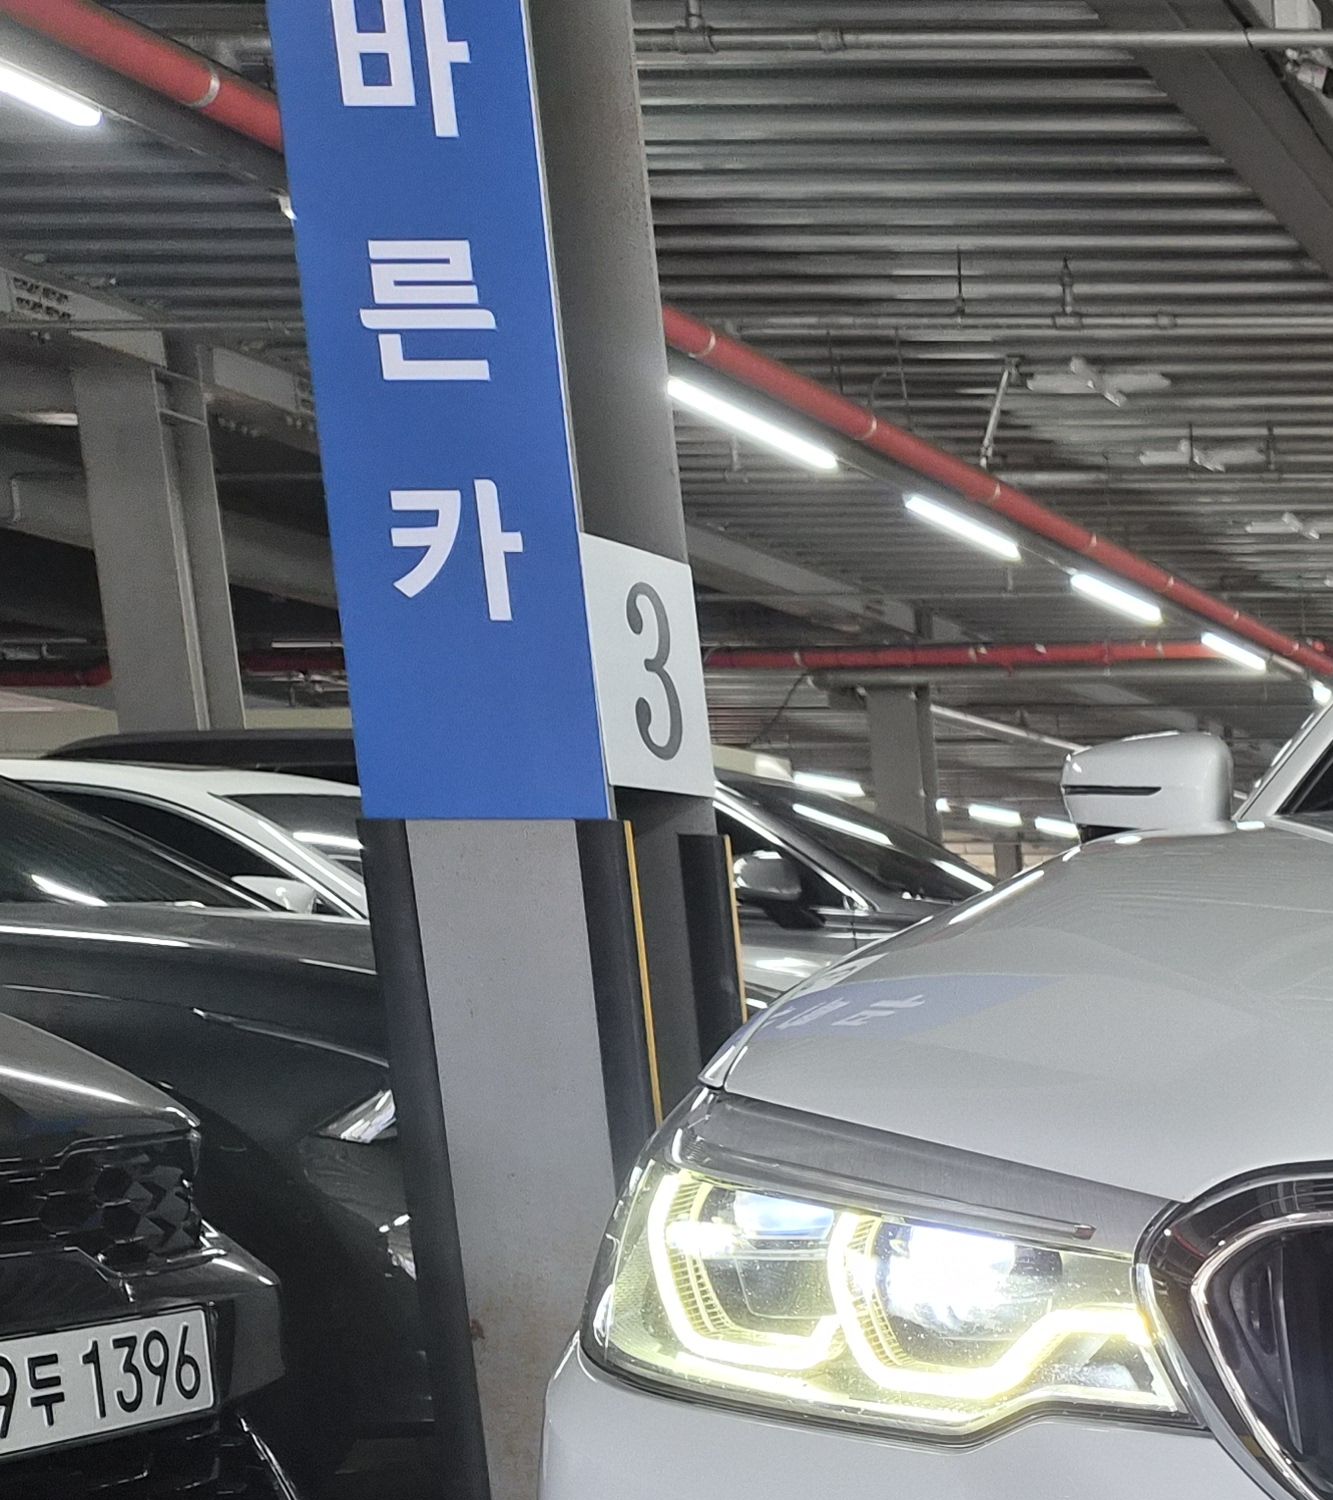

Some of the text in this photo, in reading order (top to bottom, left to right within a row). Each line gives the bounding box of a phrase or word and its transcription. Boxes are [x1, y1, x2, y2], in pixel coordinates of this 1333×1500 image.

[329, 0, 524, 622] 바른카
[625, 581, 683, 761] 3
[82, 1324, 201, 1419] 1396
